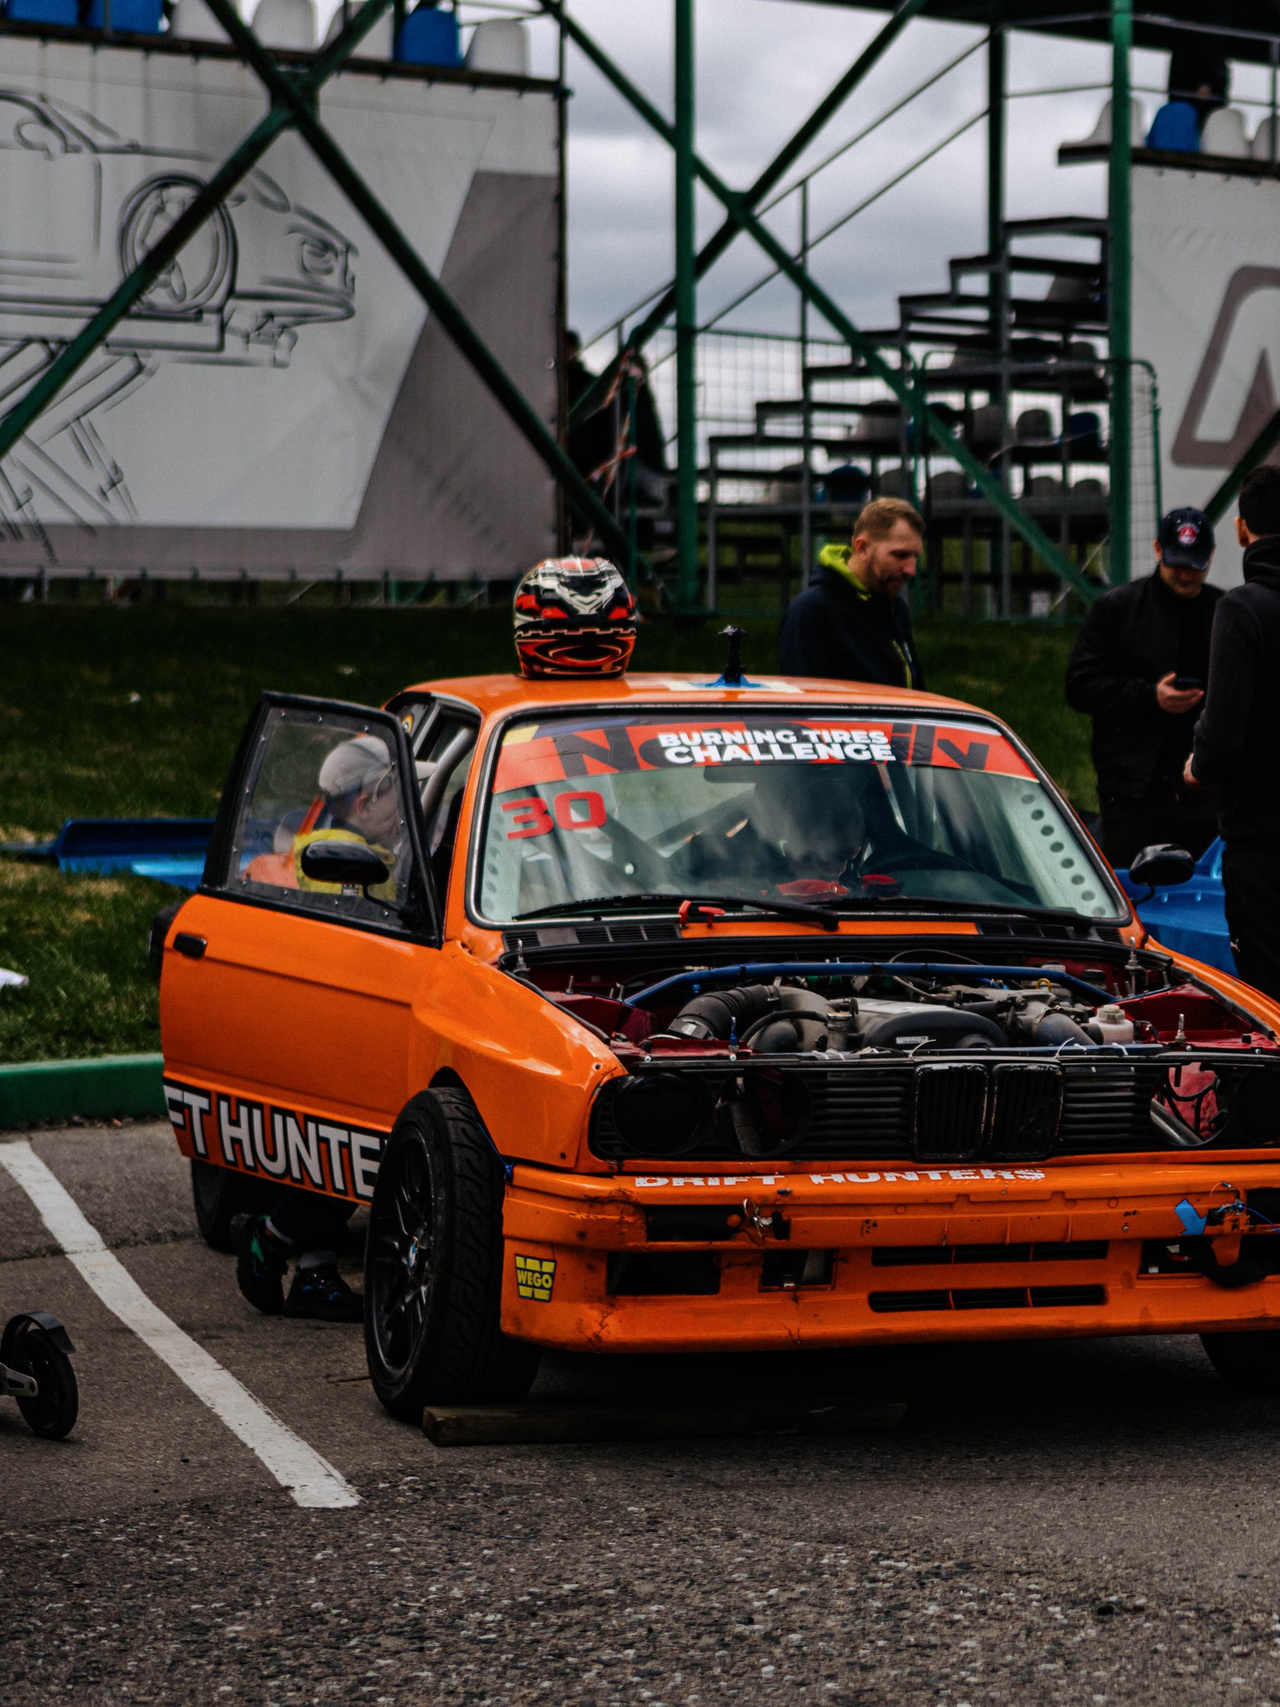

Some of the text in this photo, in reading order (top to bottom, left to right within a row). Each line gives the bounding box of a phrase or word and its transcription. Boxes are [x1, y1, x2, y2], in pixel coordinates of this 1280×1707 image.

[657, 727, 889, 748] BURNING TIRES
[664, 742, 897, 765] CHALLENGE
[500, 790, 608, 841] 30
[219, 1099, 389, 1199] HUNTE
[634, 1167, 1047, 1188] DRIFT HUNTERS
[516, 1269, 553, 1289] WEGO
